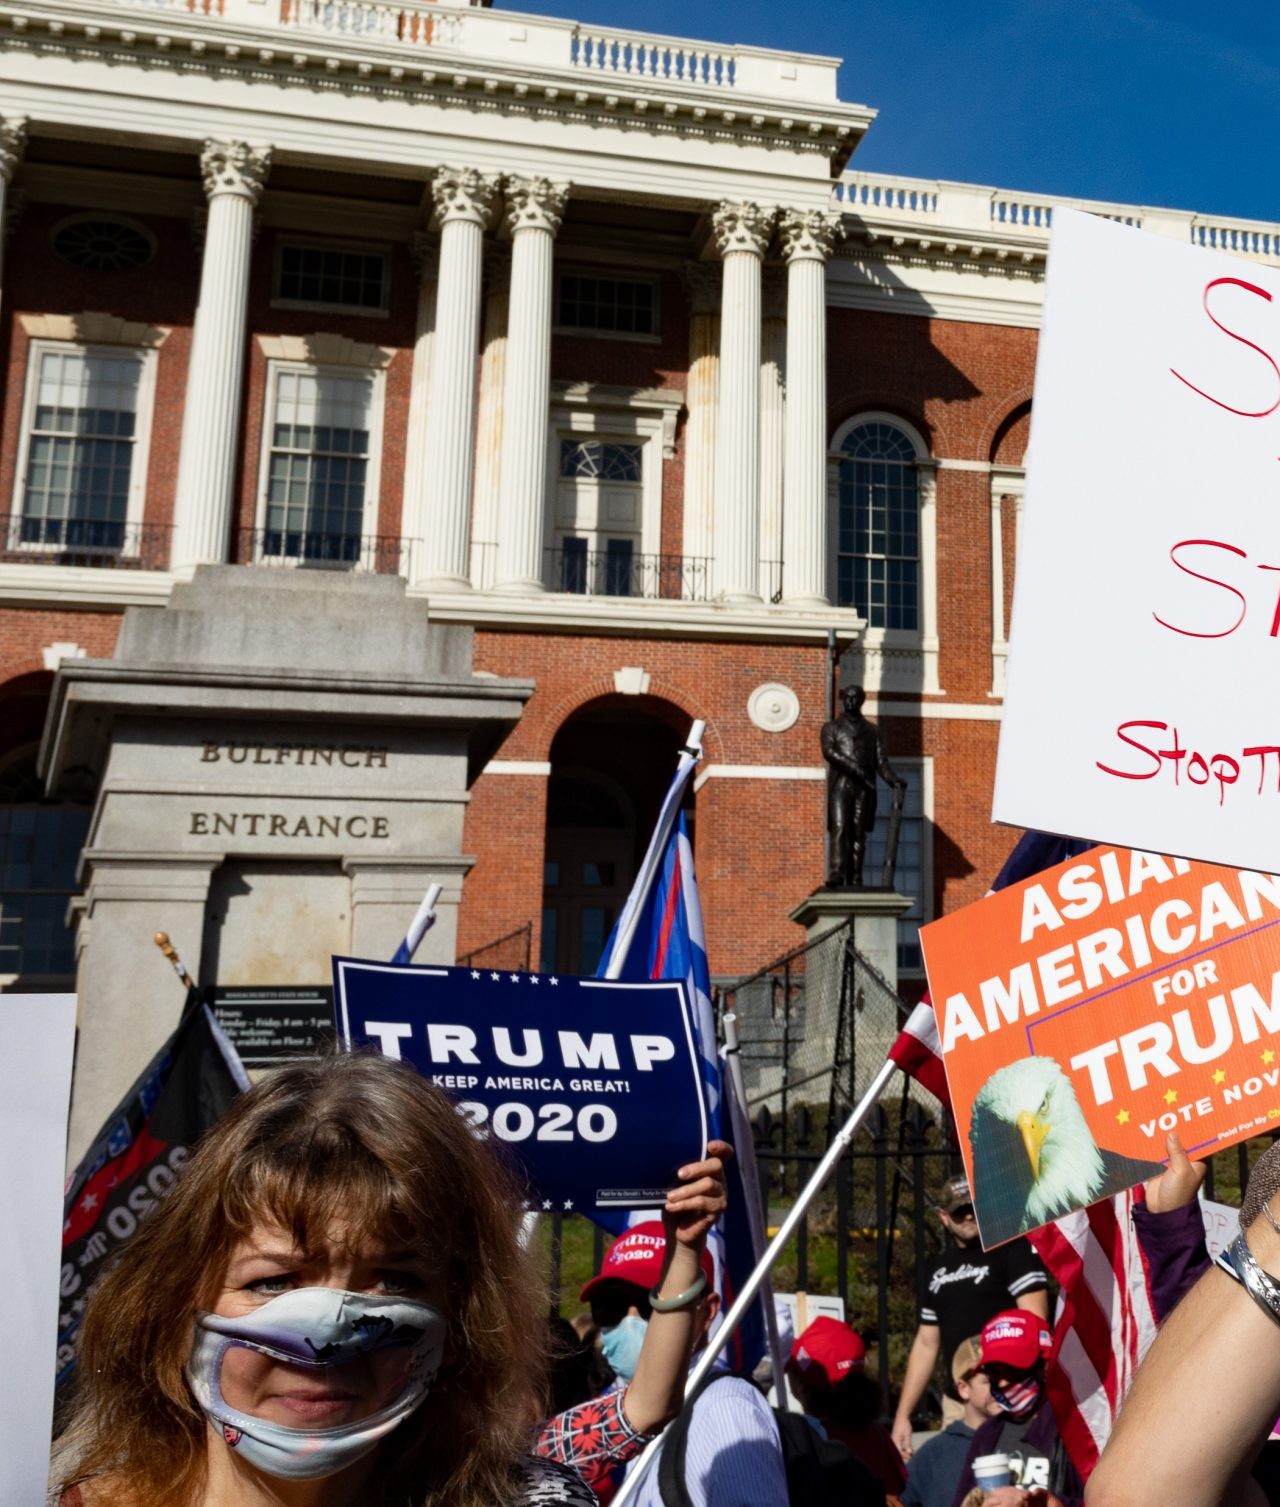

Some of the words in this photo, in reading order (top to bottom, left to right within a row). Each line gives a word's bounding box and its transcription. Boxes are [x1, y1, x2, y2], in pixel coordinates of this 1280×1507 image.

[200, 740, 388, 768] BULFINCH
[189, 812, 390, 838] ENTRANCE
[1152, 959, 1219, 1006] FOR
[365, 1021, 675, 1071] TRUMP
[432, 1075, 478, 1088] KEEP
[485, 1077, 564, 1091] AMERICA
[570, 1079, 630, 1093] GREAT!
[1140, 1097, 1214, 1138] VOTE
[1223, 1068, 1280, 1105] NOV
[455, 1101, 618, 1142] 2020
[1217, 1126, 1238, 1141] Paid
[1239, 1119, 1254, 1131] For
[1254, 1114, 1267, 1126] By
